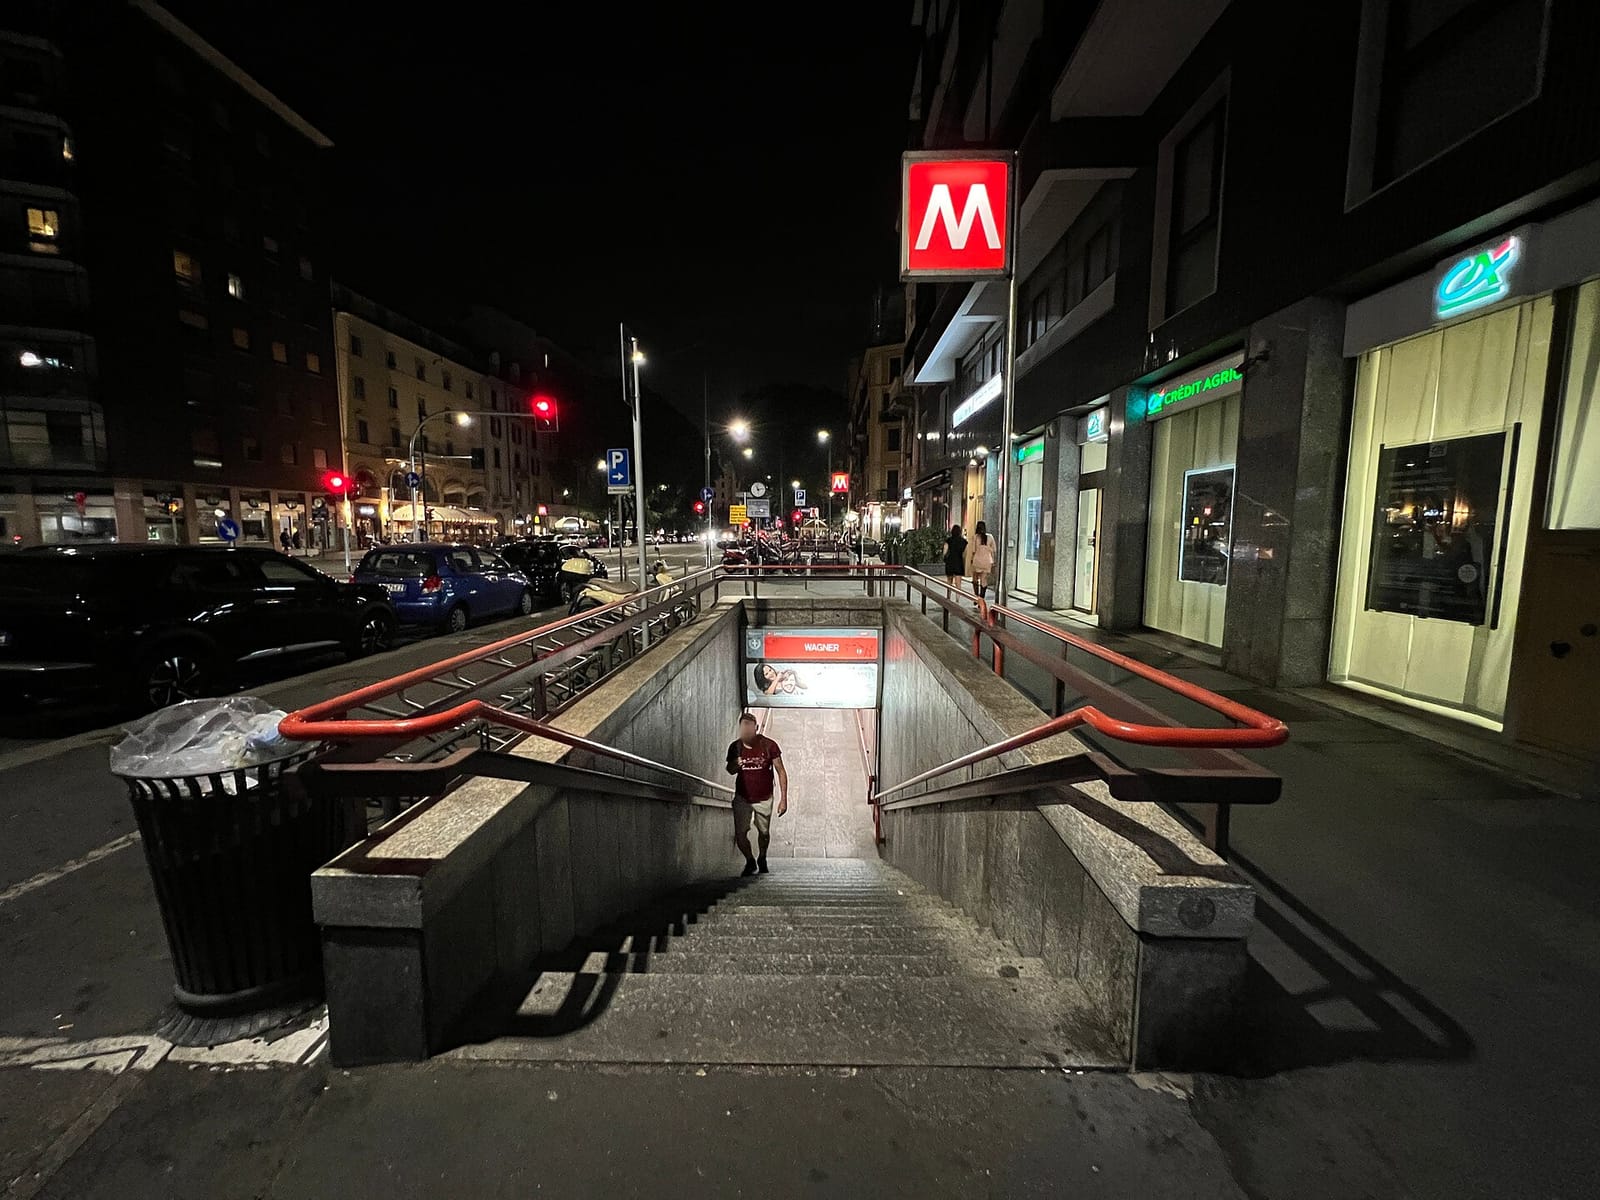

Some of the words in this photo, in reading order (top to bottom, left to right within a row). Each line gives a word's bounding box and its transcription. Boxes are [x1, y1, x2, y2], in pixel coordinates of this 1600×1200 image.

[914, 184, 1002, 250] M
[1164, 381, 1202, 405] CRÉDIT
[612, 451, 624, 469] P
[833, 475, 847, 489] M
[804, 643, 840, 652] WAGNER
